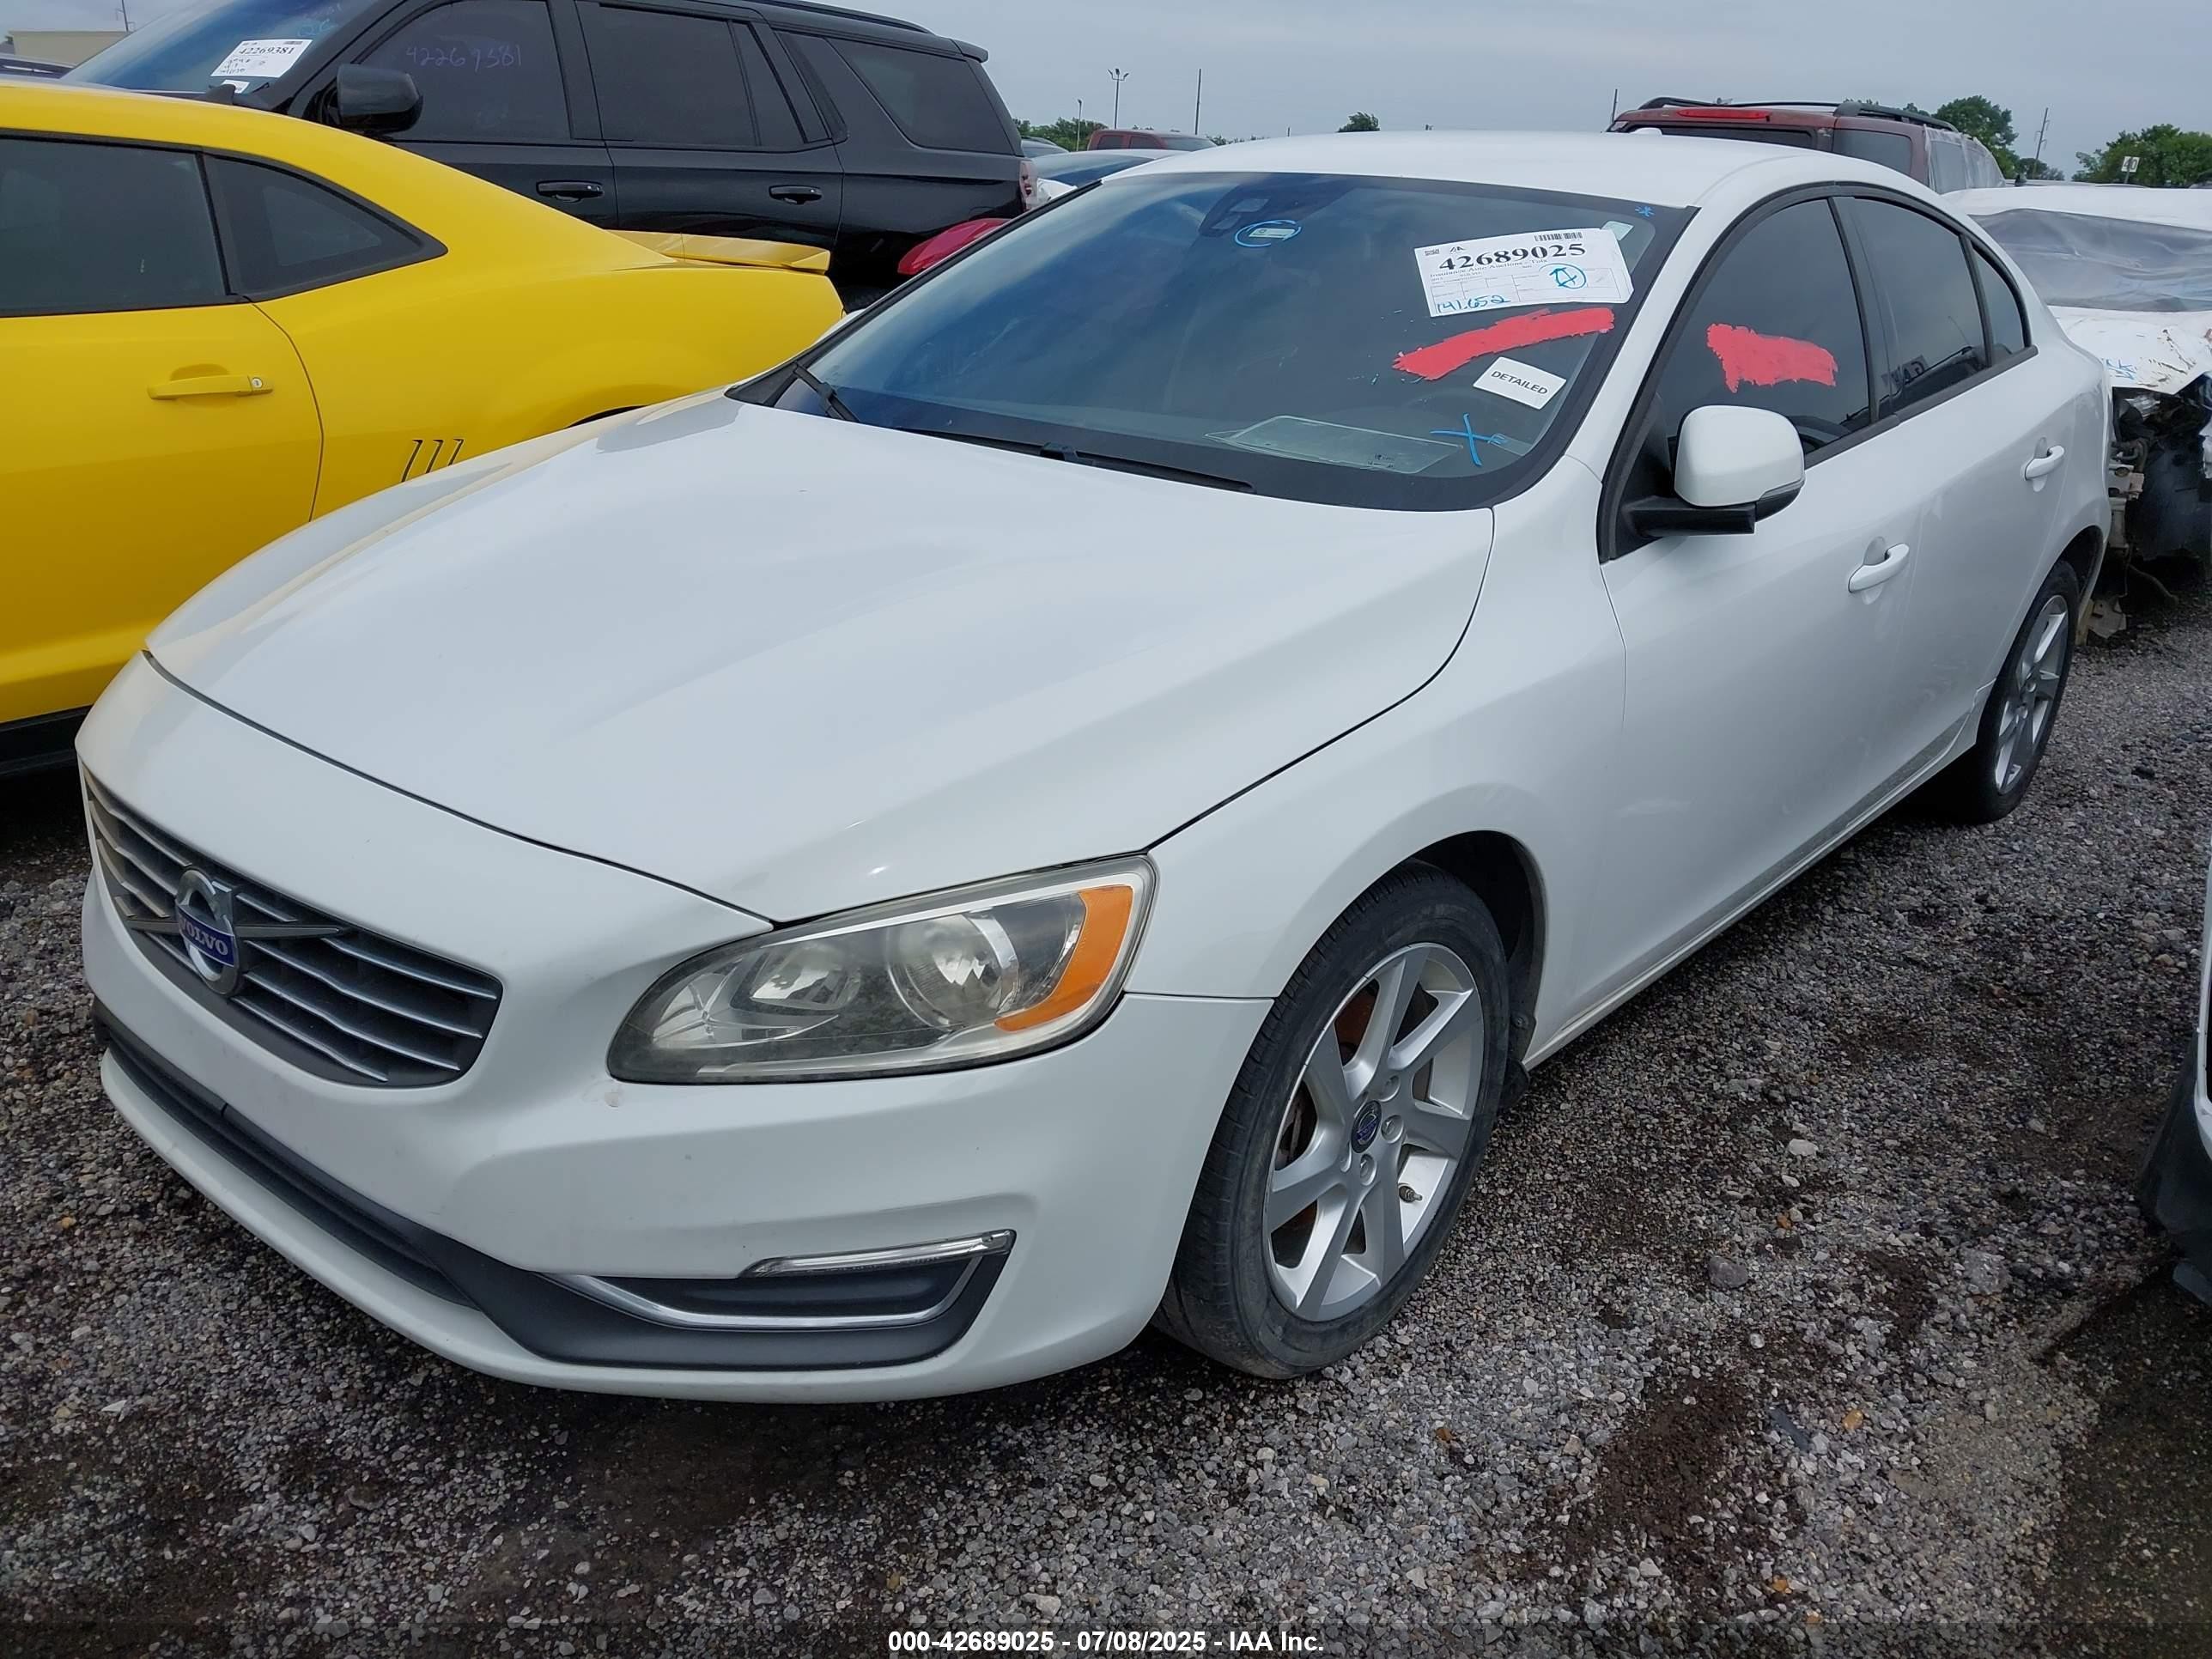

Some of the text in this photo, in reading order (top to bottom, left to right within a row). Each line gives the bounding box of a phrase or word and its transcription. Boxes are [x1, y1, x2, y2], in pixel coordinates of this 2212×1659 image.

[239, 46, 295, 55] 42269381
[1439, 243, 1585, 270] 42689025
[1491, 370, 1548, 394] DETAILED
[178, 913, 228, 957] VOLVO
